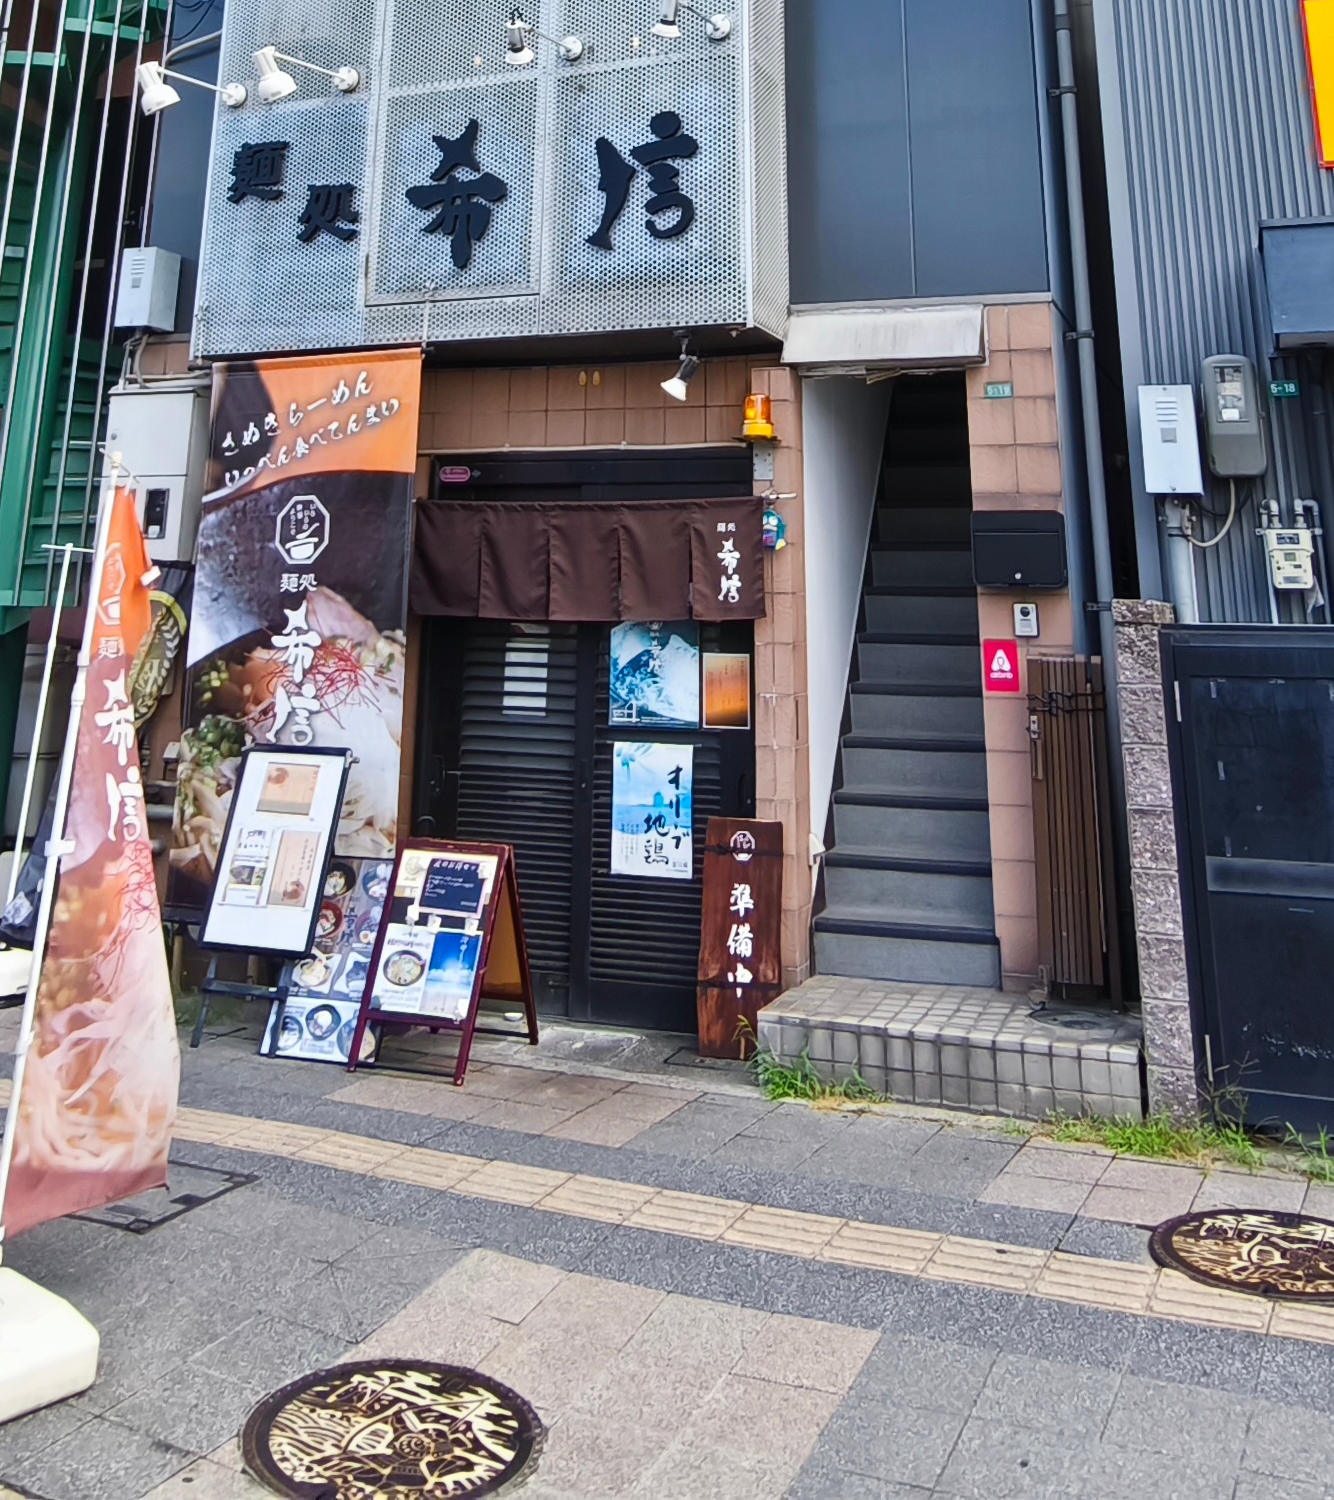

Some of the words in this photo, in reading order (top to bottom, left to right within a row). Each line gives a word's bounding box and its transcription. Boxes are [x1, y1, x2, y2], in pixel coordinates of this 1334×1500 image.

[404, 110, 700, 270] 希信
[221, 370, 375, 457] さぬきらーめん
[1270, 383, 1296, 394] 5-18
[280, 573, 317, 593] 麺処
[727, 883, 755, 998] 準備中
